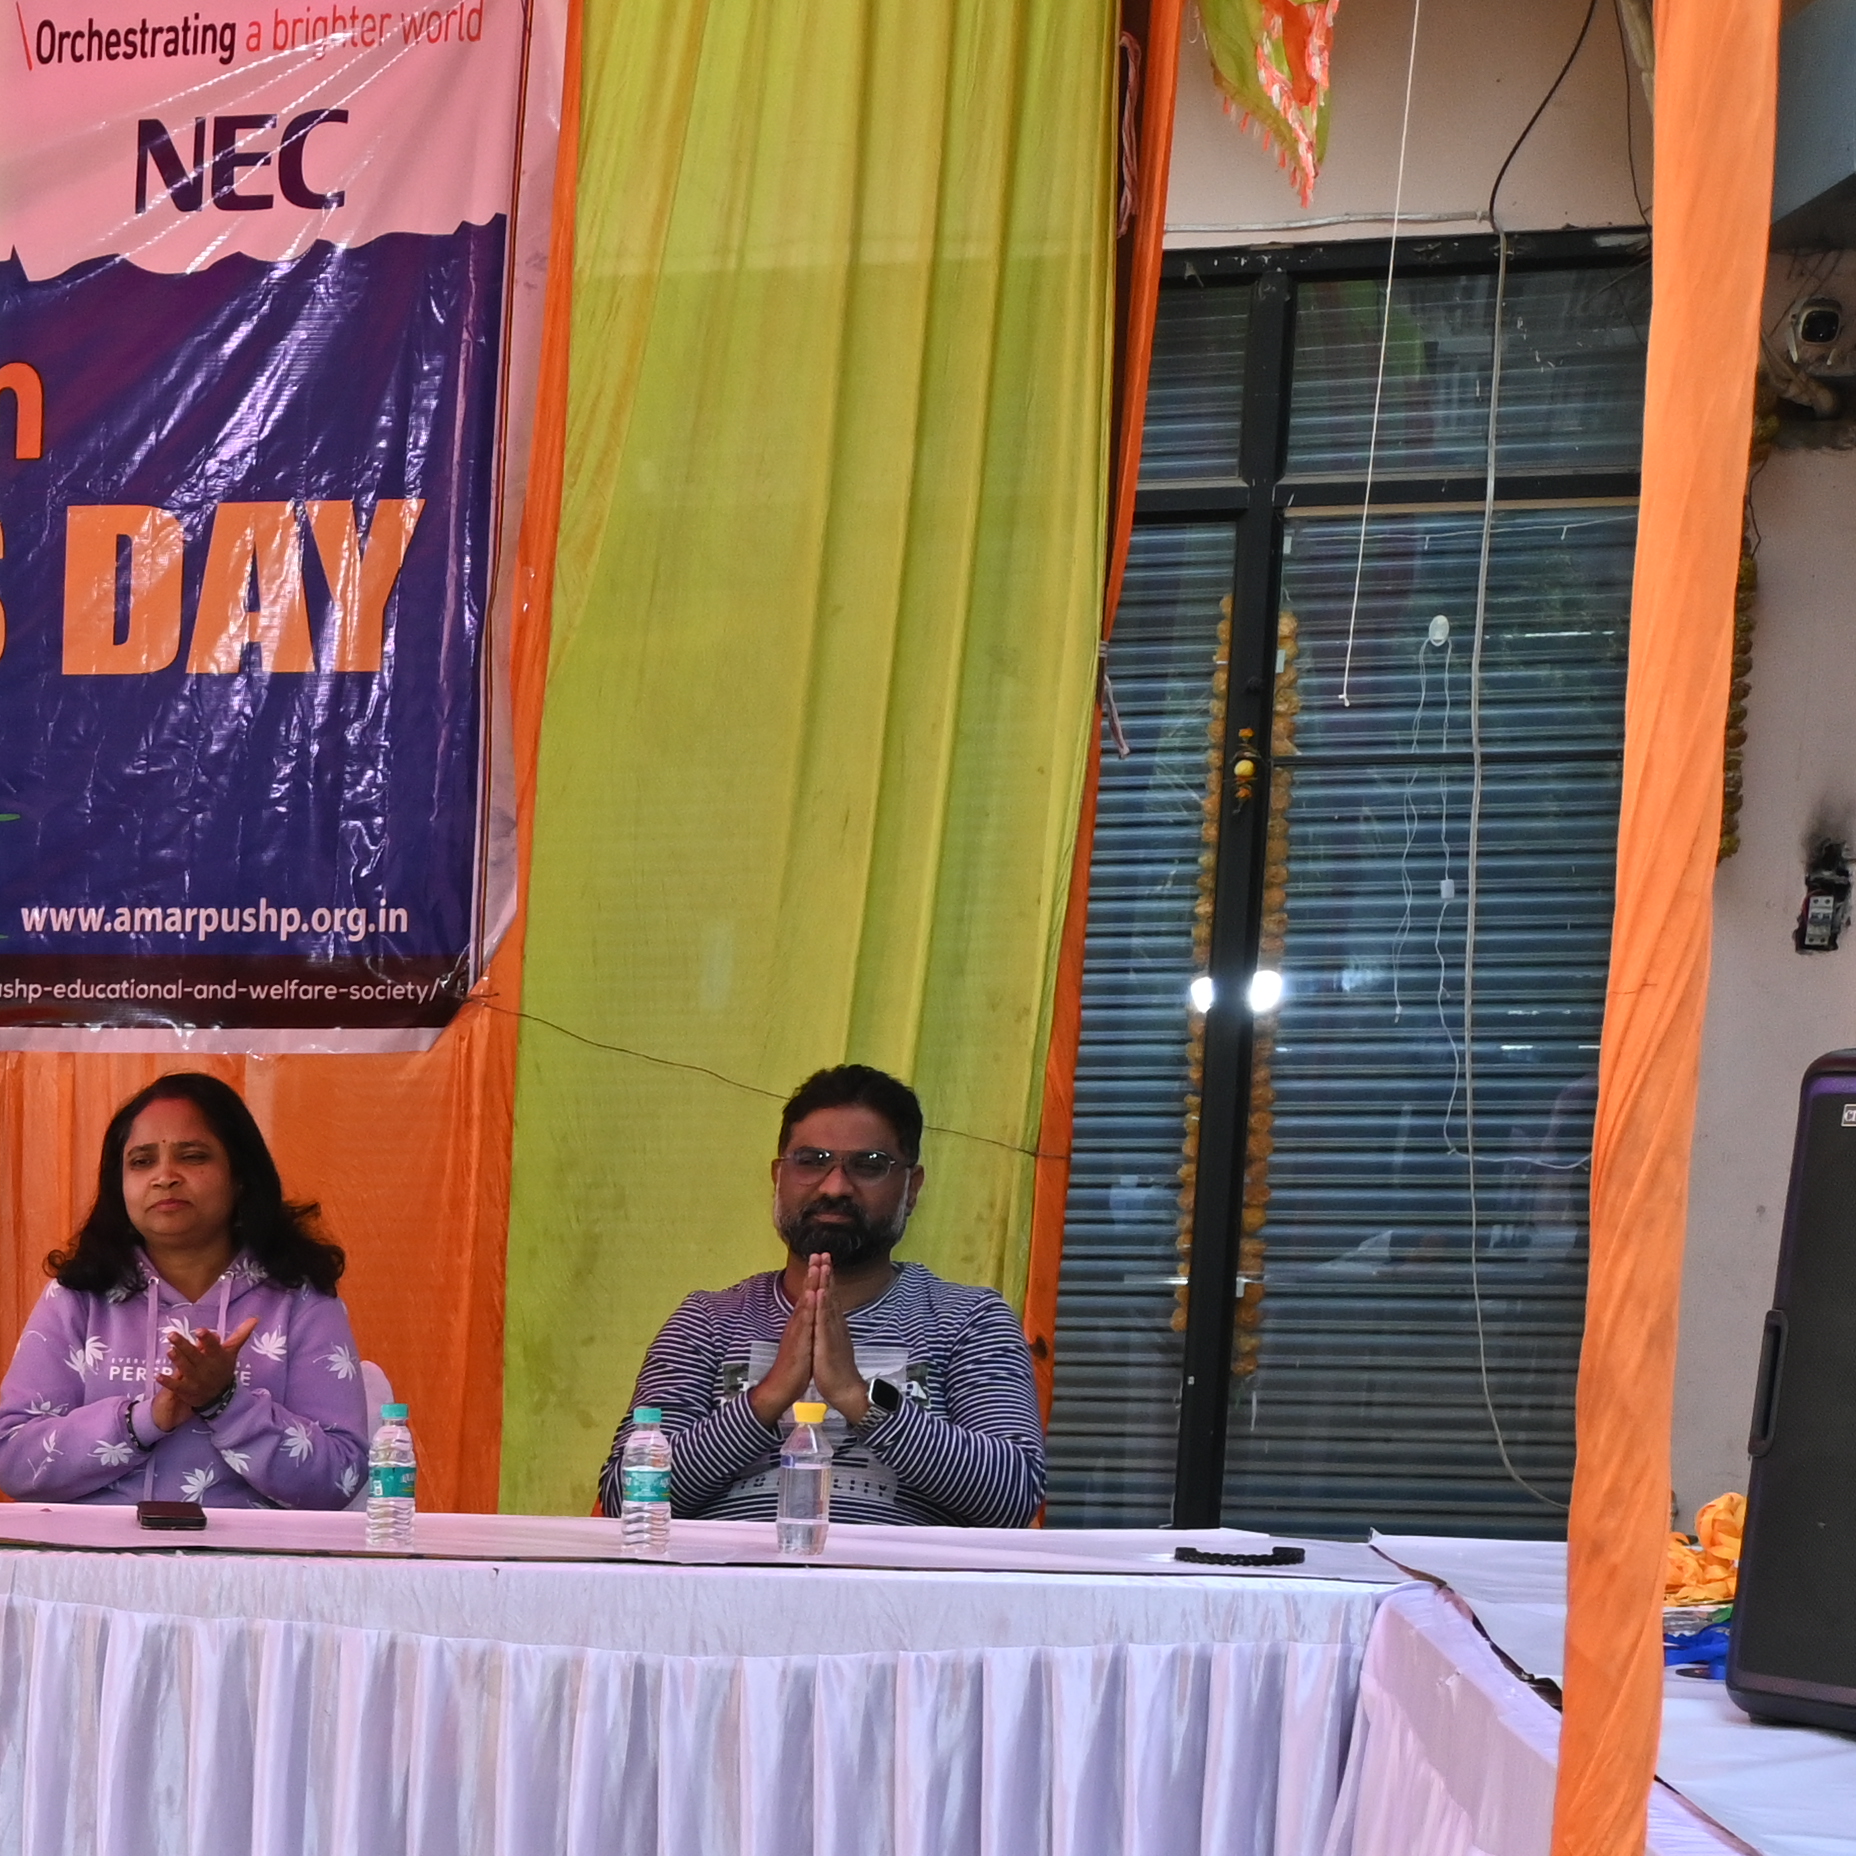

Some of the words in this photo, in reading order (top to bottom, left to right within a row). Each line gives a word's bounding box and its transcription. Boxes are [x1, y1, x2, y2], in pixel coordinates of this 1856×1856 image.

[245, 20, 262, 53] a
[273, 3, 392, 60] brighter
[400, 0, 483, 46] world
[134, 109, 350, 214] NEC
[61, 497, 425, 677] DAY
[20, 898, 410, 942] www.amarpushp.org.in
